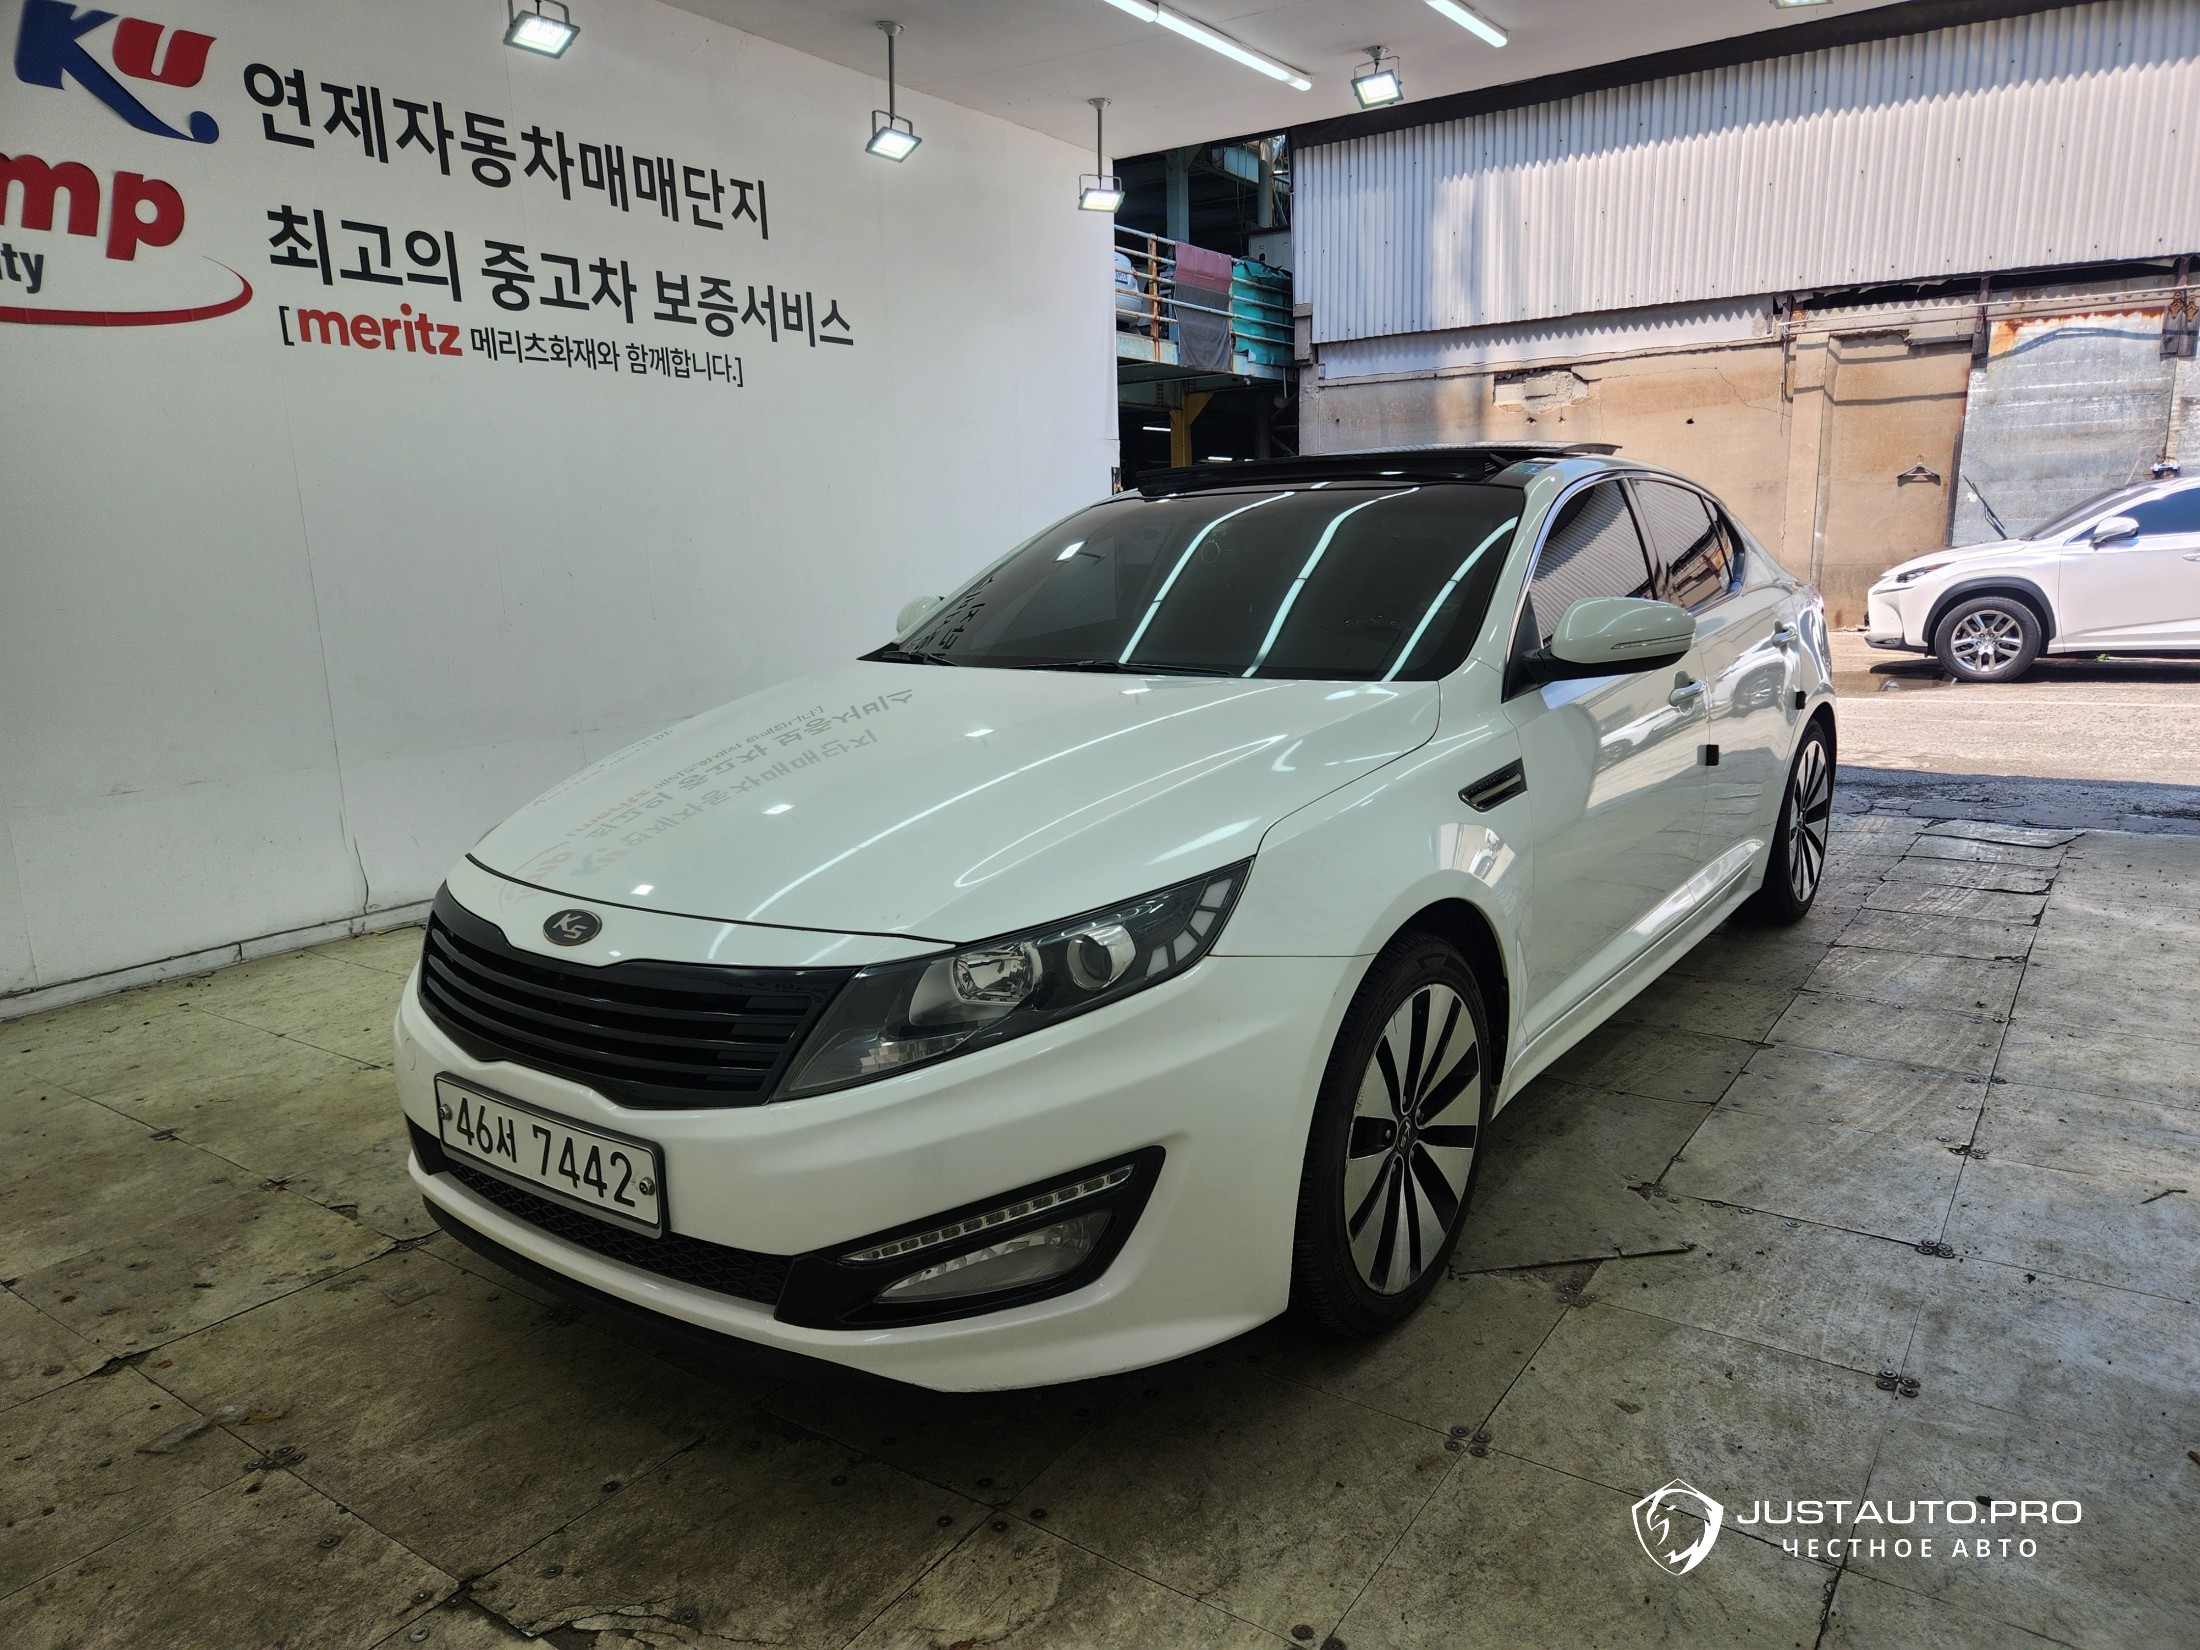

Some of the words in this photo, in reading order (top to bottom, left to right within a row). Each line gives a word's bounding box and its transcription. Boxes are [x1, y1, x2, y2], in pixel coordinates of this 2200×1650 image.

[243, 63, 769, 240] 연제자동차매매단지
[0, 243, 44, 294] ty
[266, 204, 462, 303] 최고의
[481, 239, 637, 324] 중고차
[653, 270, 855, 348] 보증서비스
[470, 327, 620, 372] 메리츠화재와
[552, 913, 589, 939] K5
[456, 1097, 517, 1163] 46서
[532, 1124, 636, 1208] 7442
